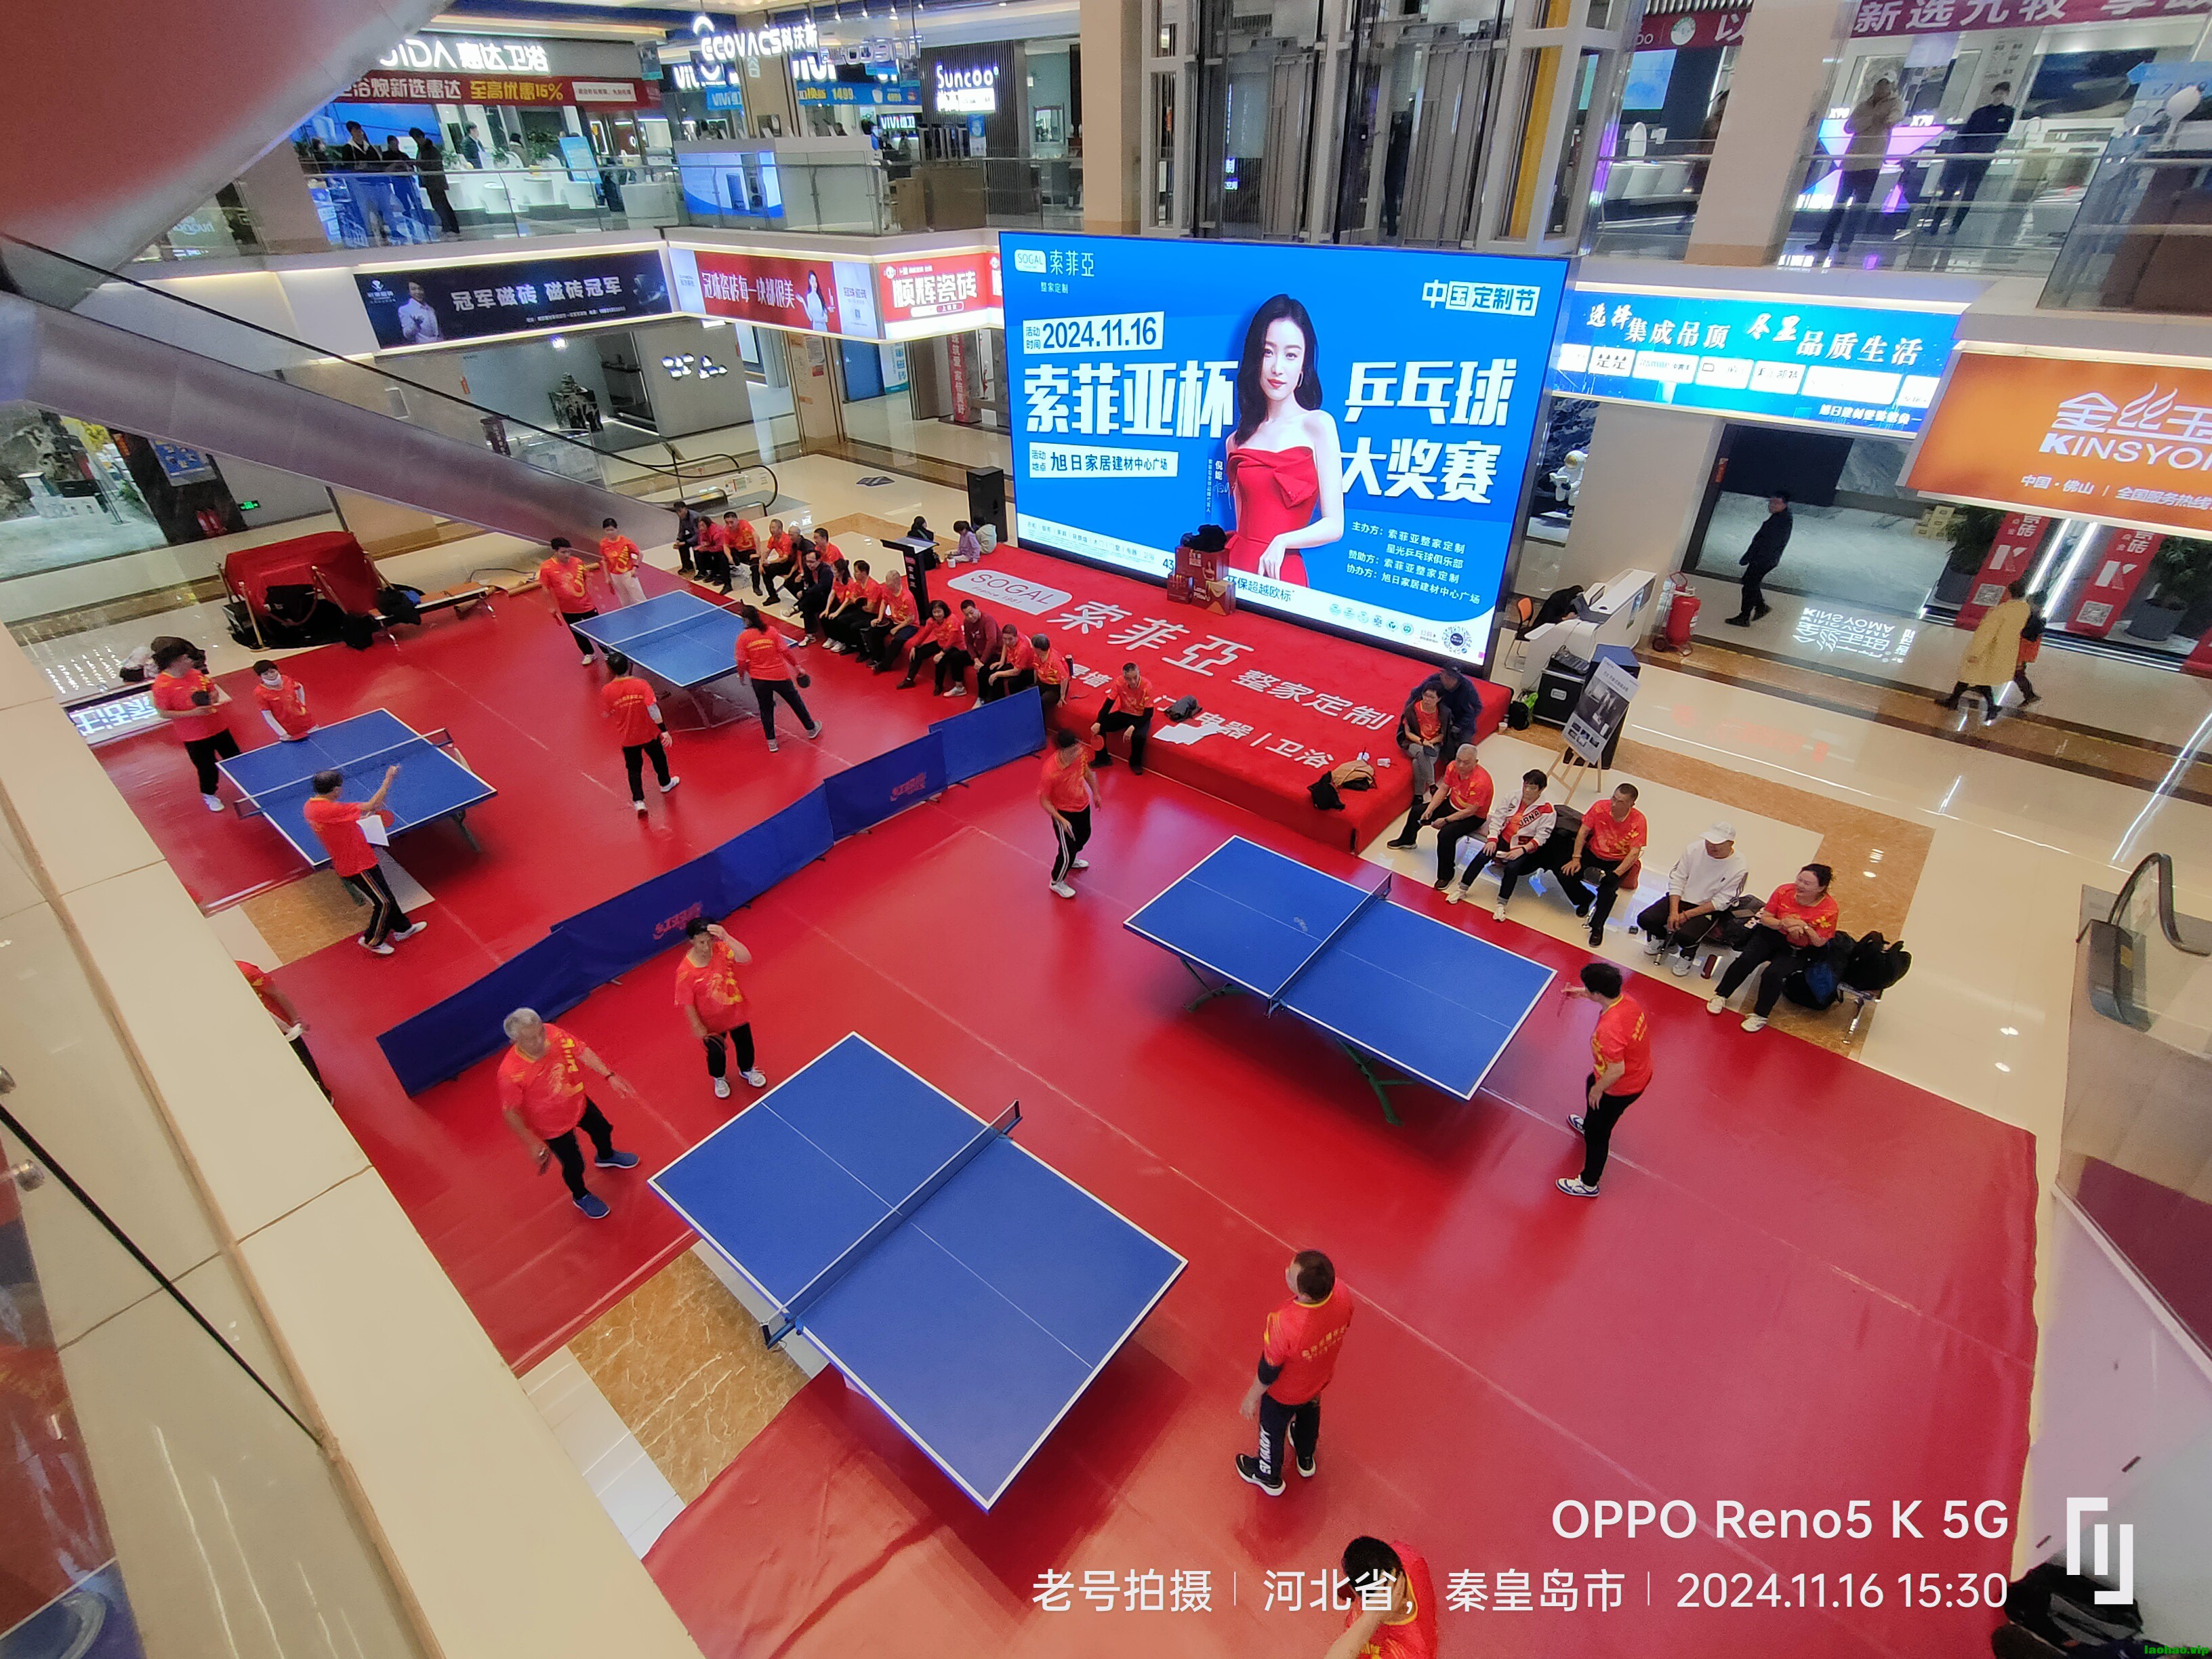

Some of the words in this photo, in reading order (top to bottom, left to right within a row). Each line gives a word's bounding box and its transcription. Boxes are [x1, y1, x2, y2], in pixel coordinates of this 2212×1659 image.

[701, 28, 781, 61] ECOVACS
[470, 80, 564, 101] 至高优惠15%
[1017, 253, 1044, 265] SOGAL
[451, 283, 538, 312] 冠军磁砖
[545, 276, 623, 303] 磁砖冠军
[701, 272, 796, 309] 冠珠瓷砖每一块都很美
[1040, 281, 1069, 294] 整家定制
[1422, 279, 1536, 312] 中国定制节
[1025, 326, 1040, 337] 活动
[1025, 340, 1041, 350] 时间
[1042, 316, 1156, 350] 2024.11.16
[1024, 360, 1239, 438] 索菲亚杯
[1344, 359, 1517, 426] 乒乓球
[1031, 449, 1046, 459] 活动
[1031, 462, 1046, 472] 地点
[1050, 451, 1168, 472] 旭日家居建材中心广场
[2039, 432, 2212, 472] KINSYO
[1340, 436, 1502, 504] 大奖赛
[2021, 474, 2095, 495] 中国·佛山
[1351, 520, 1384, 536] 主办方：
[1387, 529, 1465, 554] 索菲亚整家定制
[1348, 549, 1379, 565] 赞助方：
[1384, 557, 1459, 584] 索菲亚整家定制
[1386, 543, 1464, 569] 星光乒乓球俱乐部
[970, 574, 1054, 605] SOGAL
[1346, 563, 1377, 579] 协办方：
[1381, 572, 1481, 605] 旭日家居建材中心广场
[1046, 600, 1254, 676] 索菲亞
[1231, 669, 1395, 731] 整家定制
[1195, 712, 1254, 739] 电器
[1265, 738, 1334, 769] 卫浴
